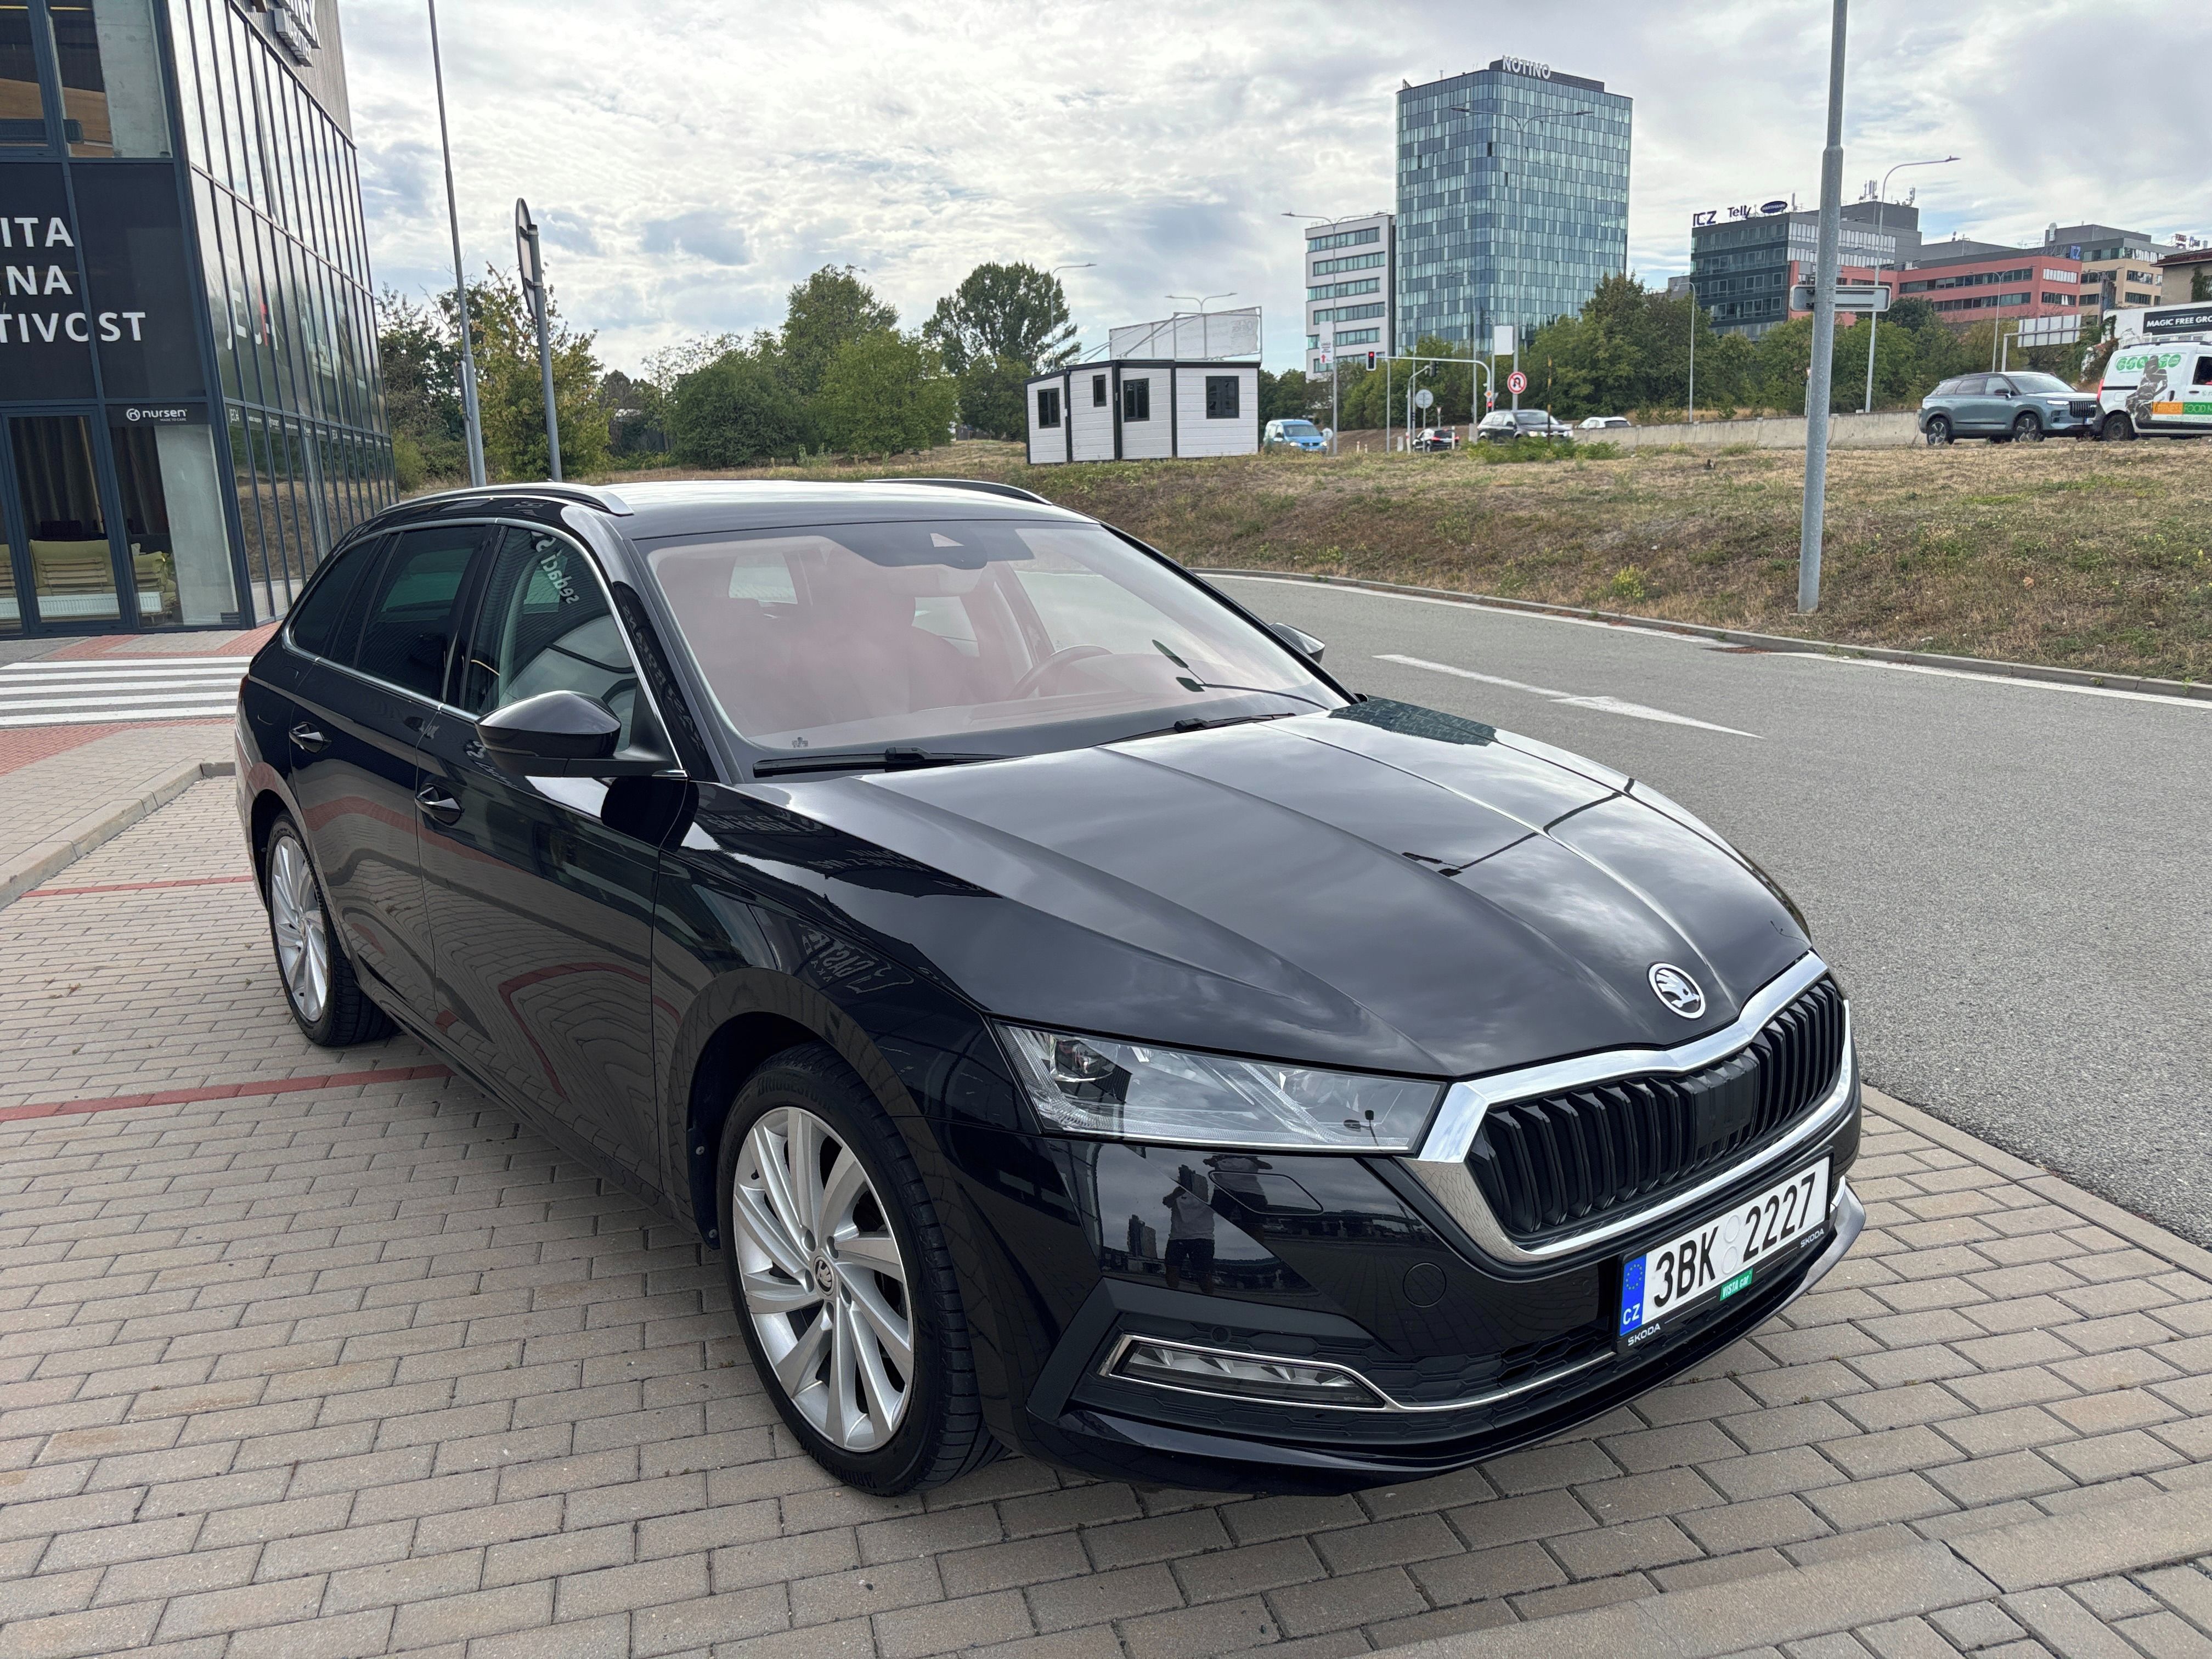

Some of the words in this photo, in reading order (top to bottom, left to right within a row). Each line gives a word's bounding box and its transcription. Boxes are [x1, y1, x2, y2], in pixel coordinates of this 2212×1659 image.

[1502, 55, 1550, 79] NOTINO
[1693, 211, 1717, 227] ICZ
[1727, 205, 1751, 219] Telly
[1, 217, 75, 247] ITA
[2146, 319, 2174, 328] MAGIC
[143, 409, 186, 417] nursen
[1654, 1226, 1719, 1307] 3BK
[1743, 1171, 1815, 1262] 2227
[1723, 1280, 1739, 1297] VISTA
[1623, 1303, 1640, 1325] CZ
[1628, 1323, 1661, 1346] SKODA
